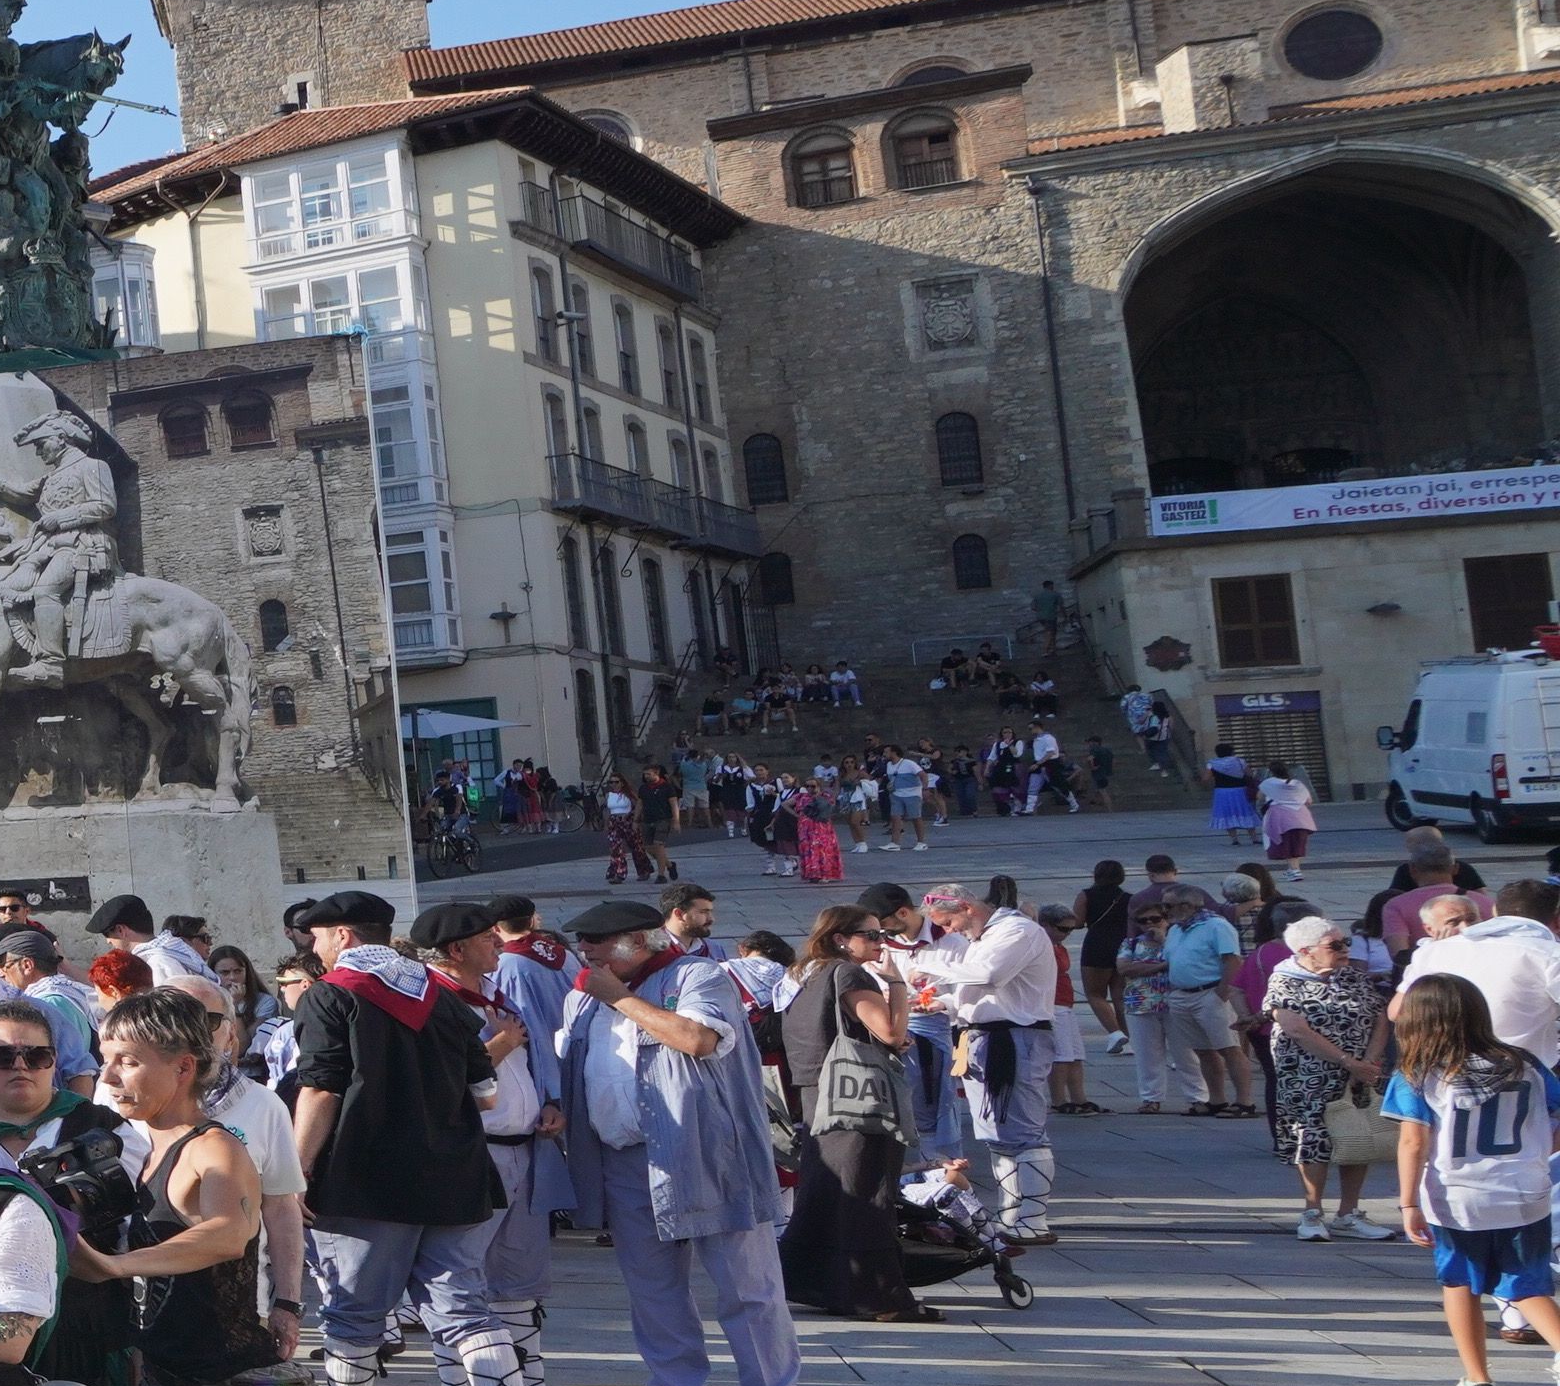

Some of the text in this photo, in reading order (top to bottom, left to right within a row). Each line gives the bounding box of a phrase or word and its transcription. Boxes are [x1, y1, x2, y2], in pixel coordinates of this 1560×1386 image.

[1332, 482, 1421, 501] Jaietan
[1426, 479, 1463, 496] jai,
[1160, 500, 1206, 512] VITORIA
[1161, 510, 1207, 522] GASTEIZ
[1293, 507, 1319, 520] En
[1328, 498, 1413, 518] fiestas,
[1417, 491, 1526, 510] diversión
[1532, 492, 1546, 505] y
[839, 1075, 888, 1104] DA!
[1452, 1080, 1532, 1159] 10
